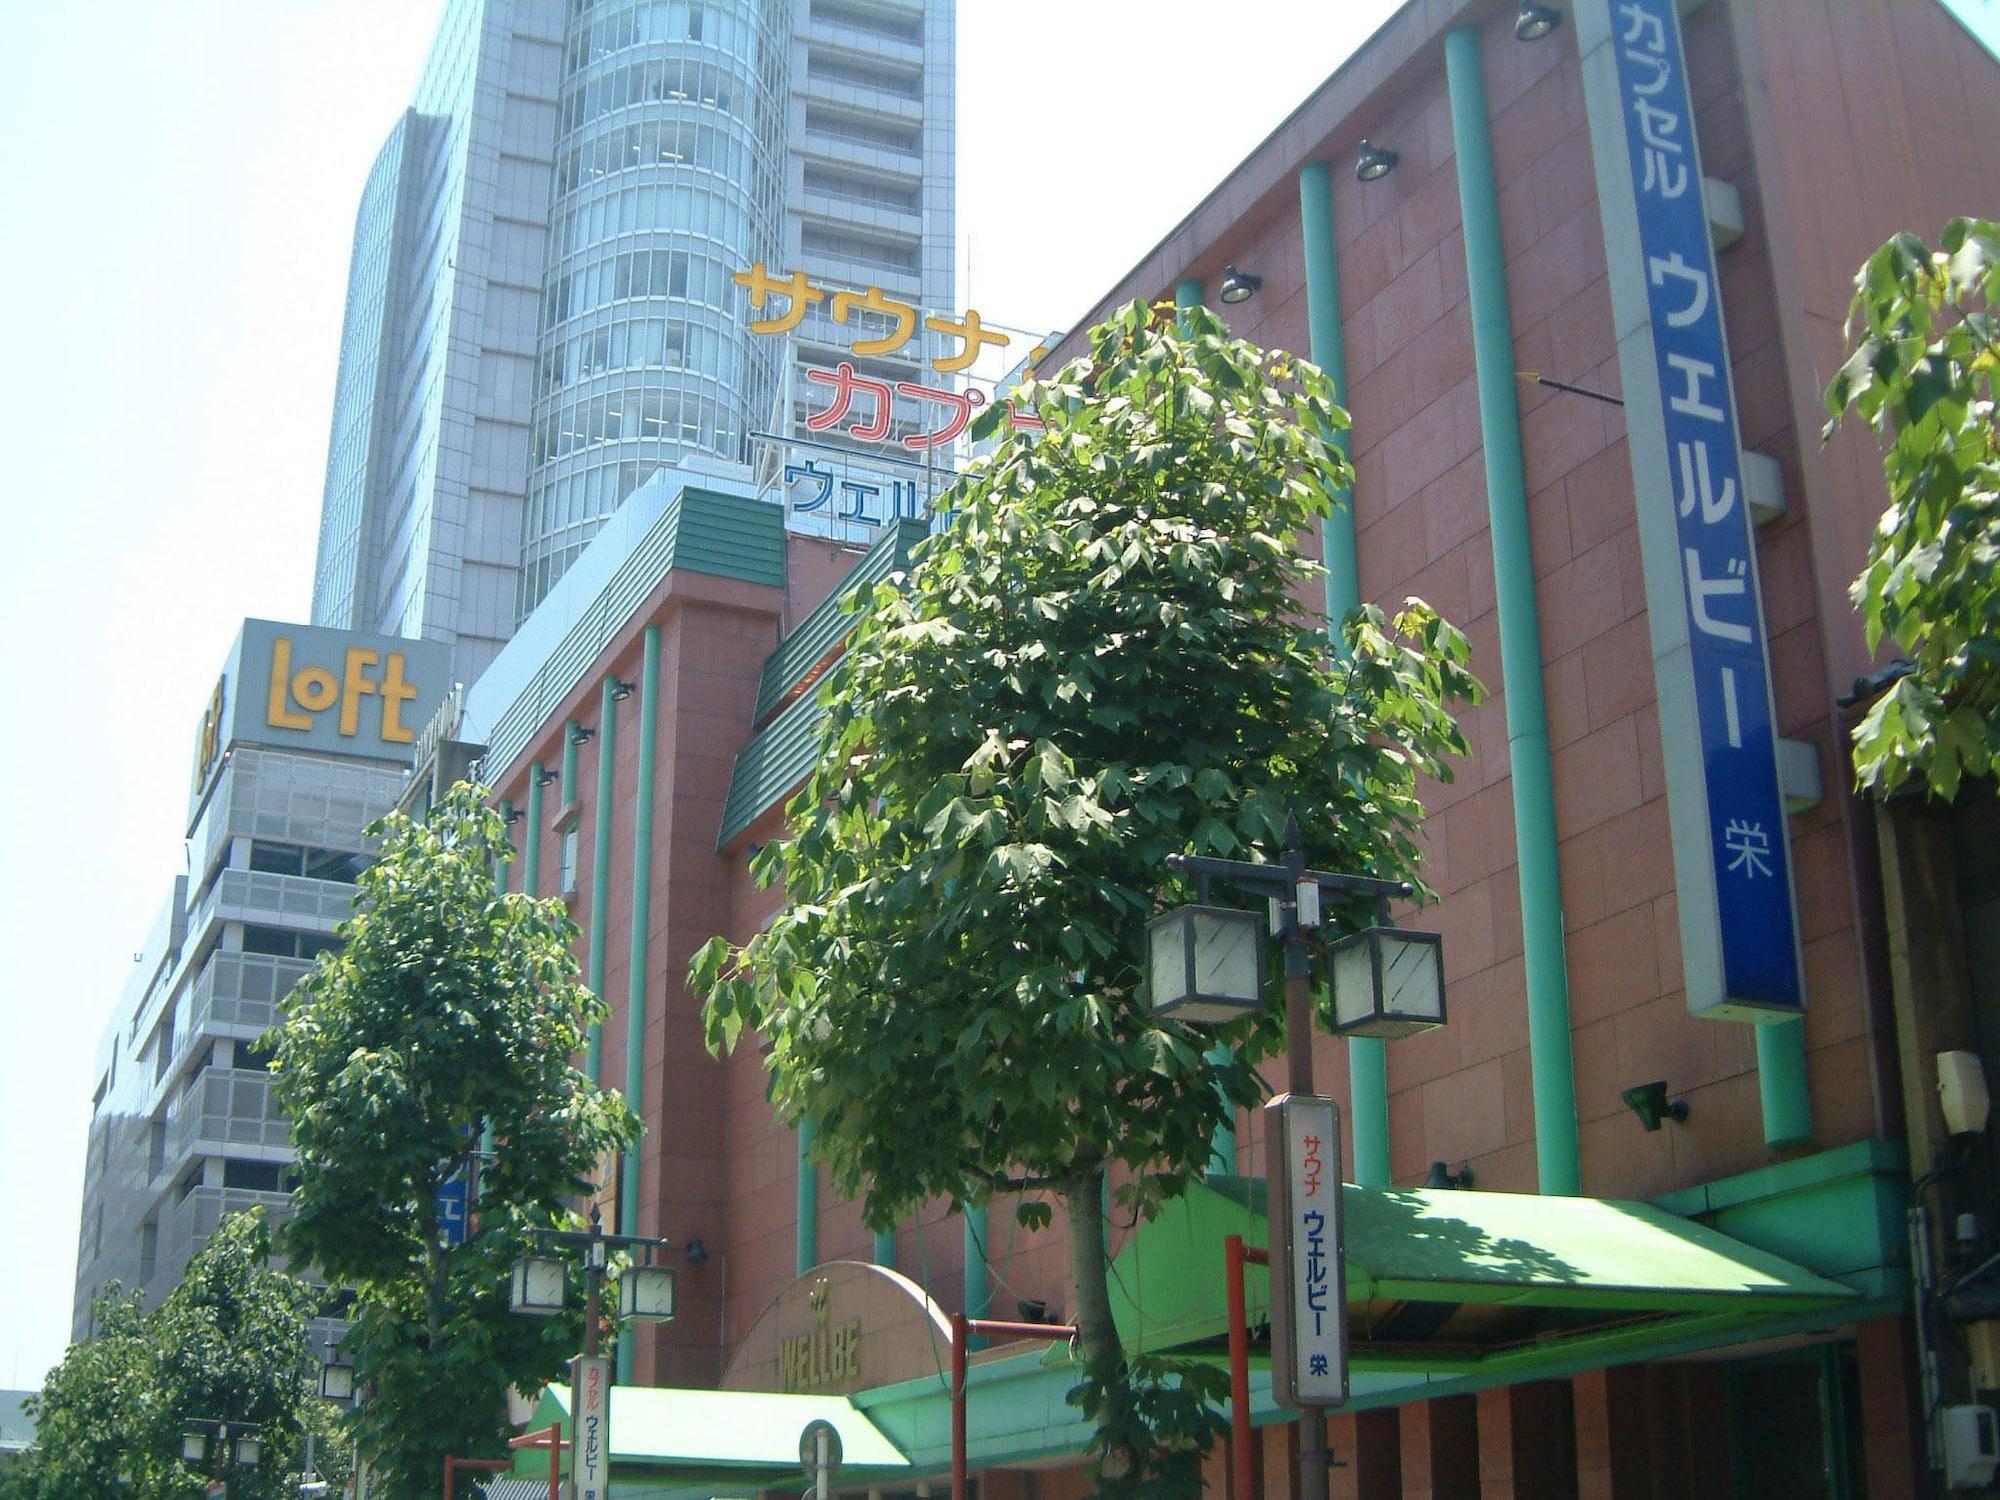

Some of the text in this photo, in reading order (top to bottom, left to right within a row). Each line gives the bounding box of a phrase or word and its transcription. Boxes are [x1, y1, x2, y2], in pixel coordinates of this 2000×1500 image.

[732, 262, 1048, 386] サウナ
[1620, 3, 1688, 199] カプセル
[1724, 820, 1773, 879] 栄
[1303, 1135, 1322, 1198] サウナ
[1309, 1354, 1329, 1377] 栄
